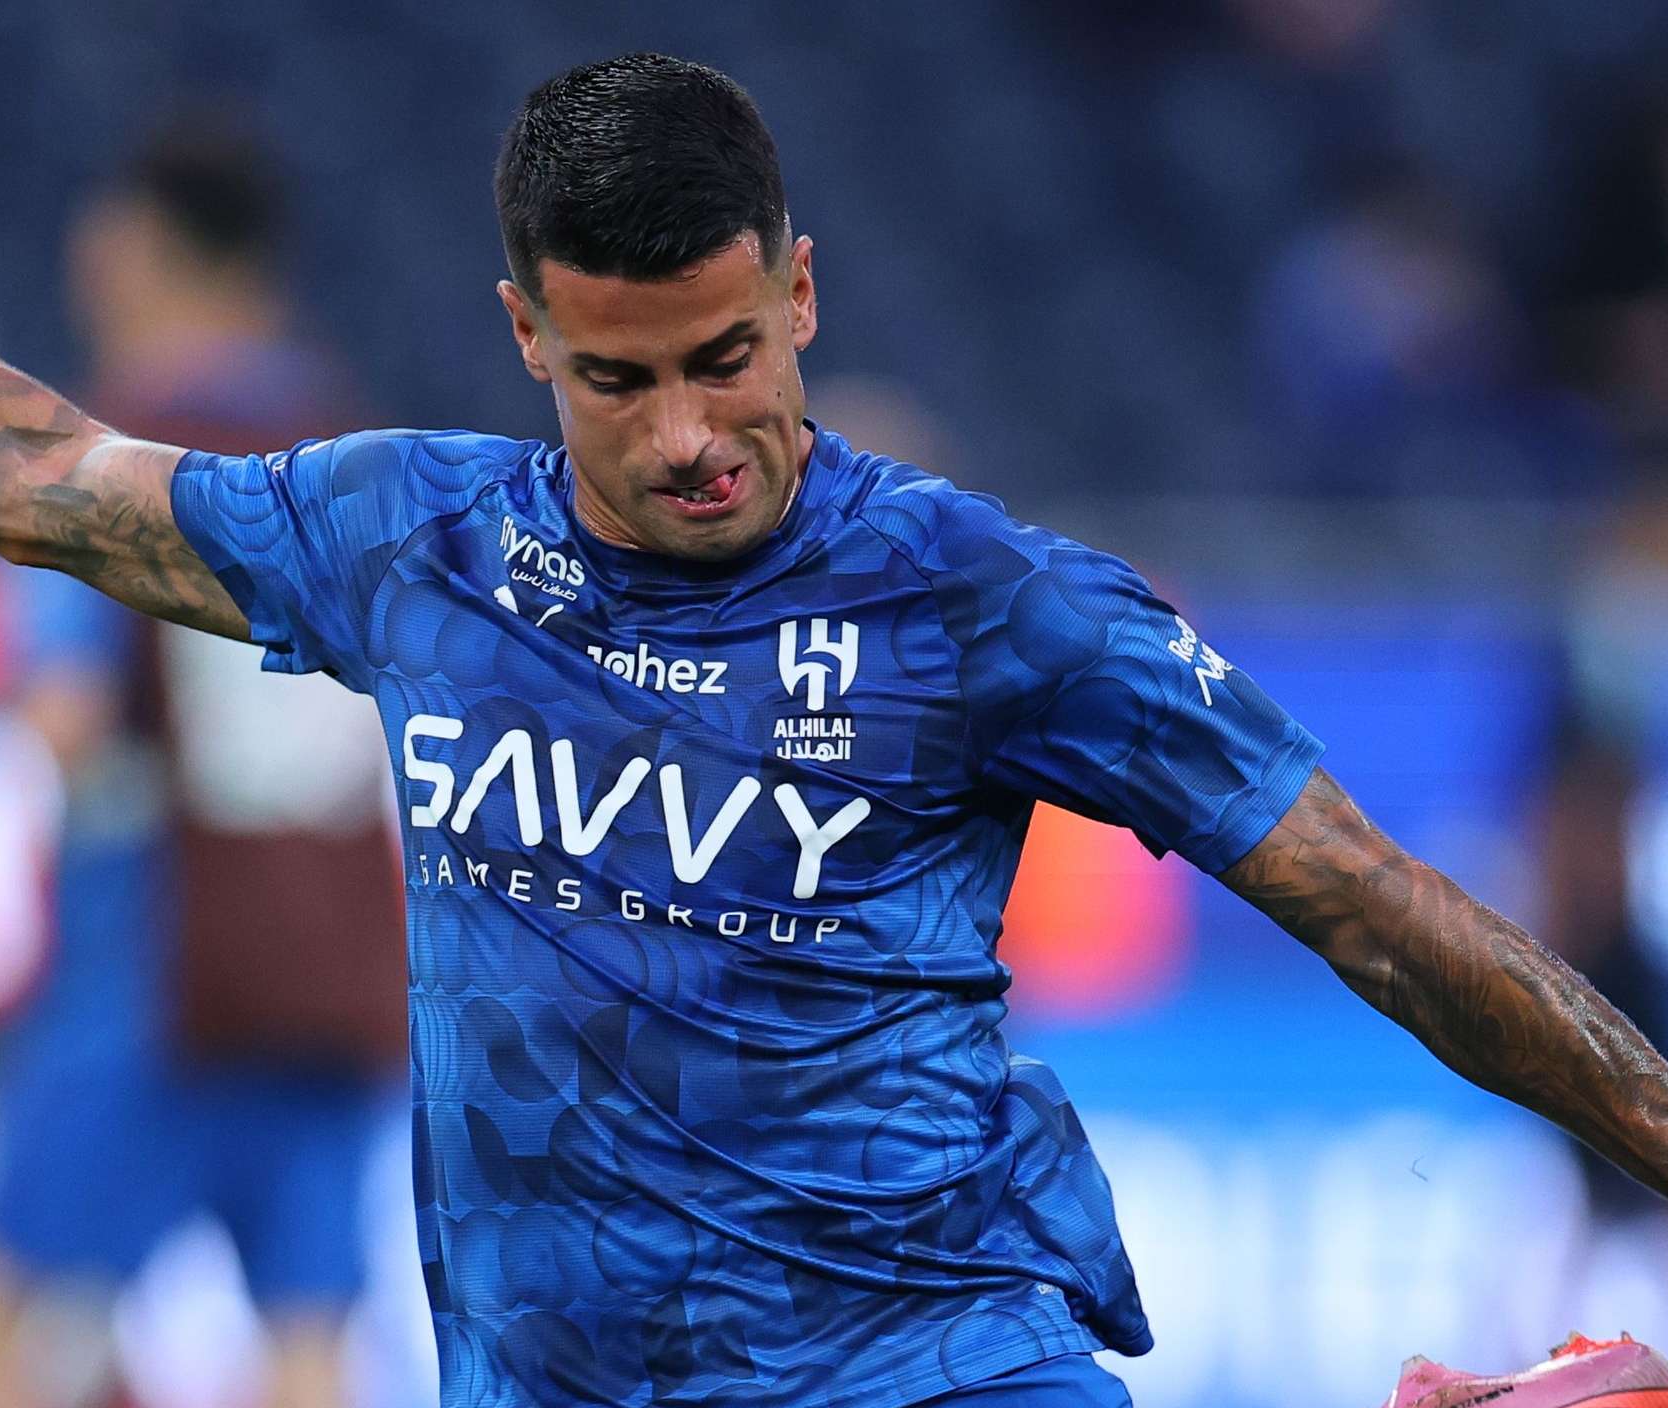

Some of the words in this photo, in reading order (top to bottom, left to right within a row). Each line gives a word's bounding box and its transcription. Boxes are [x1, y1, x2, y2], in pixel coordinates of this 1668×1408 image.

[773, 717, 857, 739] ALHILAL
[776, 739, 851, 763] الهلال
[404, 714, 872, 899] SAVVY
[620, 889, 841, 944] GROUP
